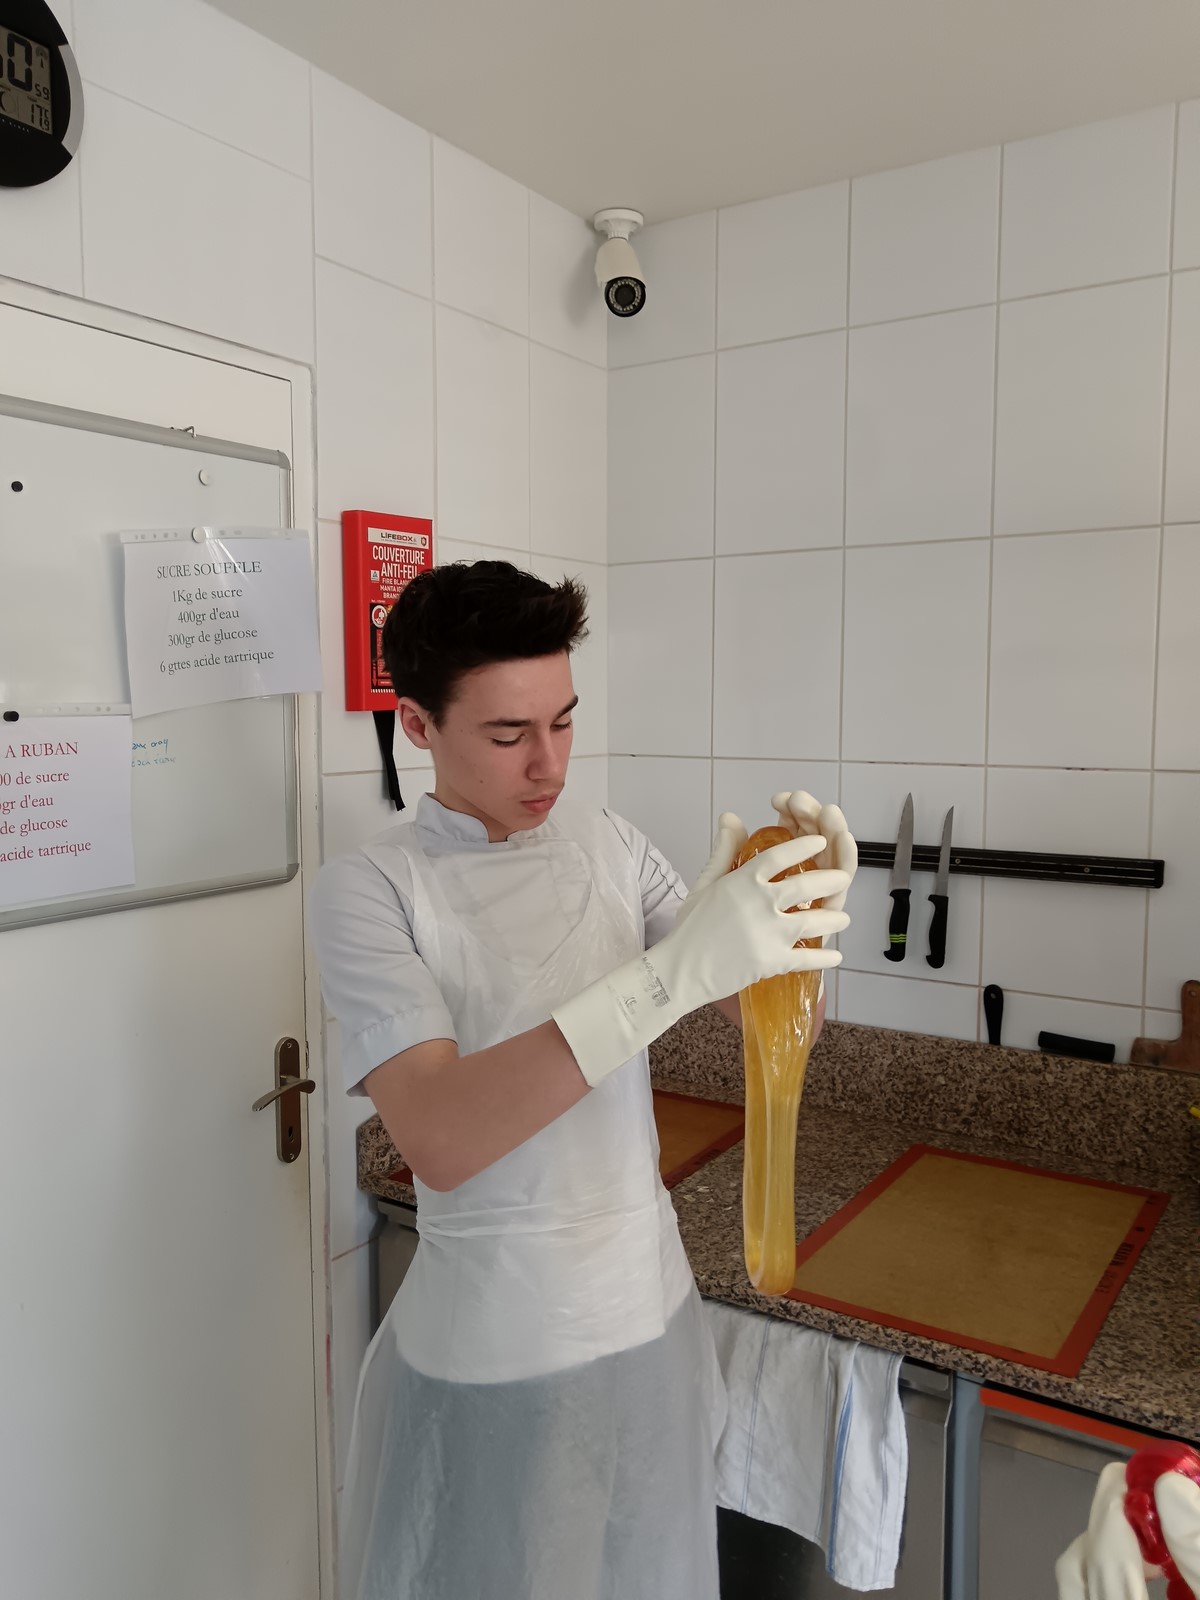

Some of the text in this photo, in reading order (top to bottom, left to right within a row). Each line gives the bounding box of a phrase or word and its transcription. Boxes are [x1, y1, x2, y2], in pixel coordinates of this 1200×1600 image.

[372, 545, 425, 565] COUVERTURE
[157, 561, 262, 579] SUCRE SOUFFLE
[381, 562, 418, 580] ANTI-FEU
[380, 585, 396, 593] MANTA
[382, 577, 393, 585] FIRE
[172, 587, 243, 605] 1Kg de sucre
[177, 608, 240, 625] 400gr d'eau
[168, 629, 258, 648] 300gr de glucose
[159, 649, 274, 675] 6 gttes acide tartrique
[5, 742, 79, 758] A RUBAN
[16, 771, 32, 785] de
[36, 771, 70, 784] sucre
[20, 794, 54, 809] d'eau
[0, 818, 68, 837] de glucose
[0, 841, 92, 862] acide tartrique
